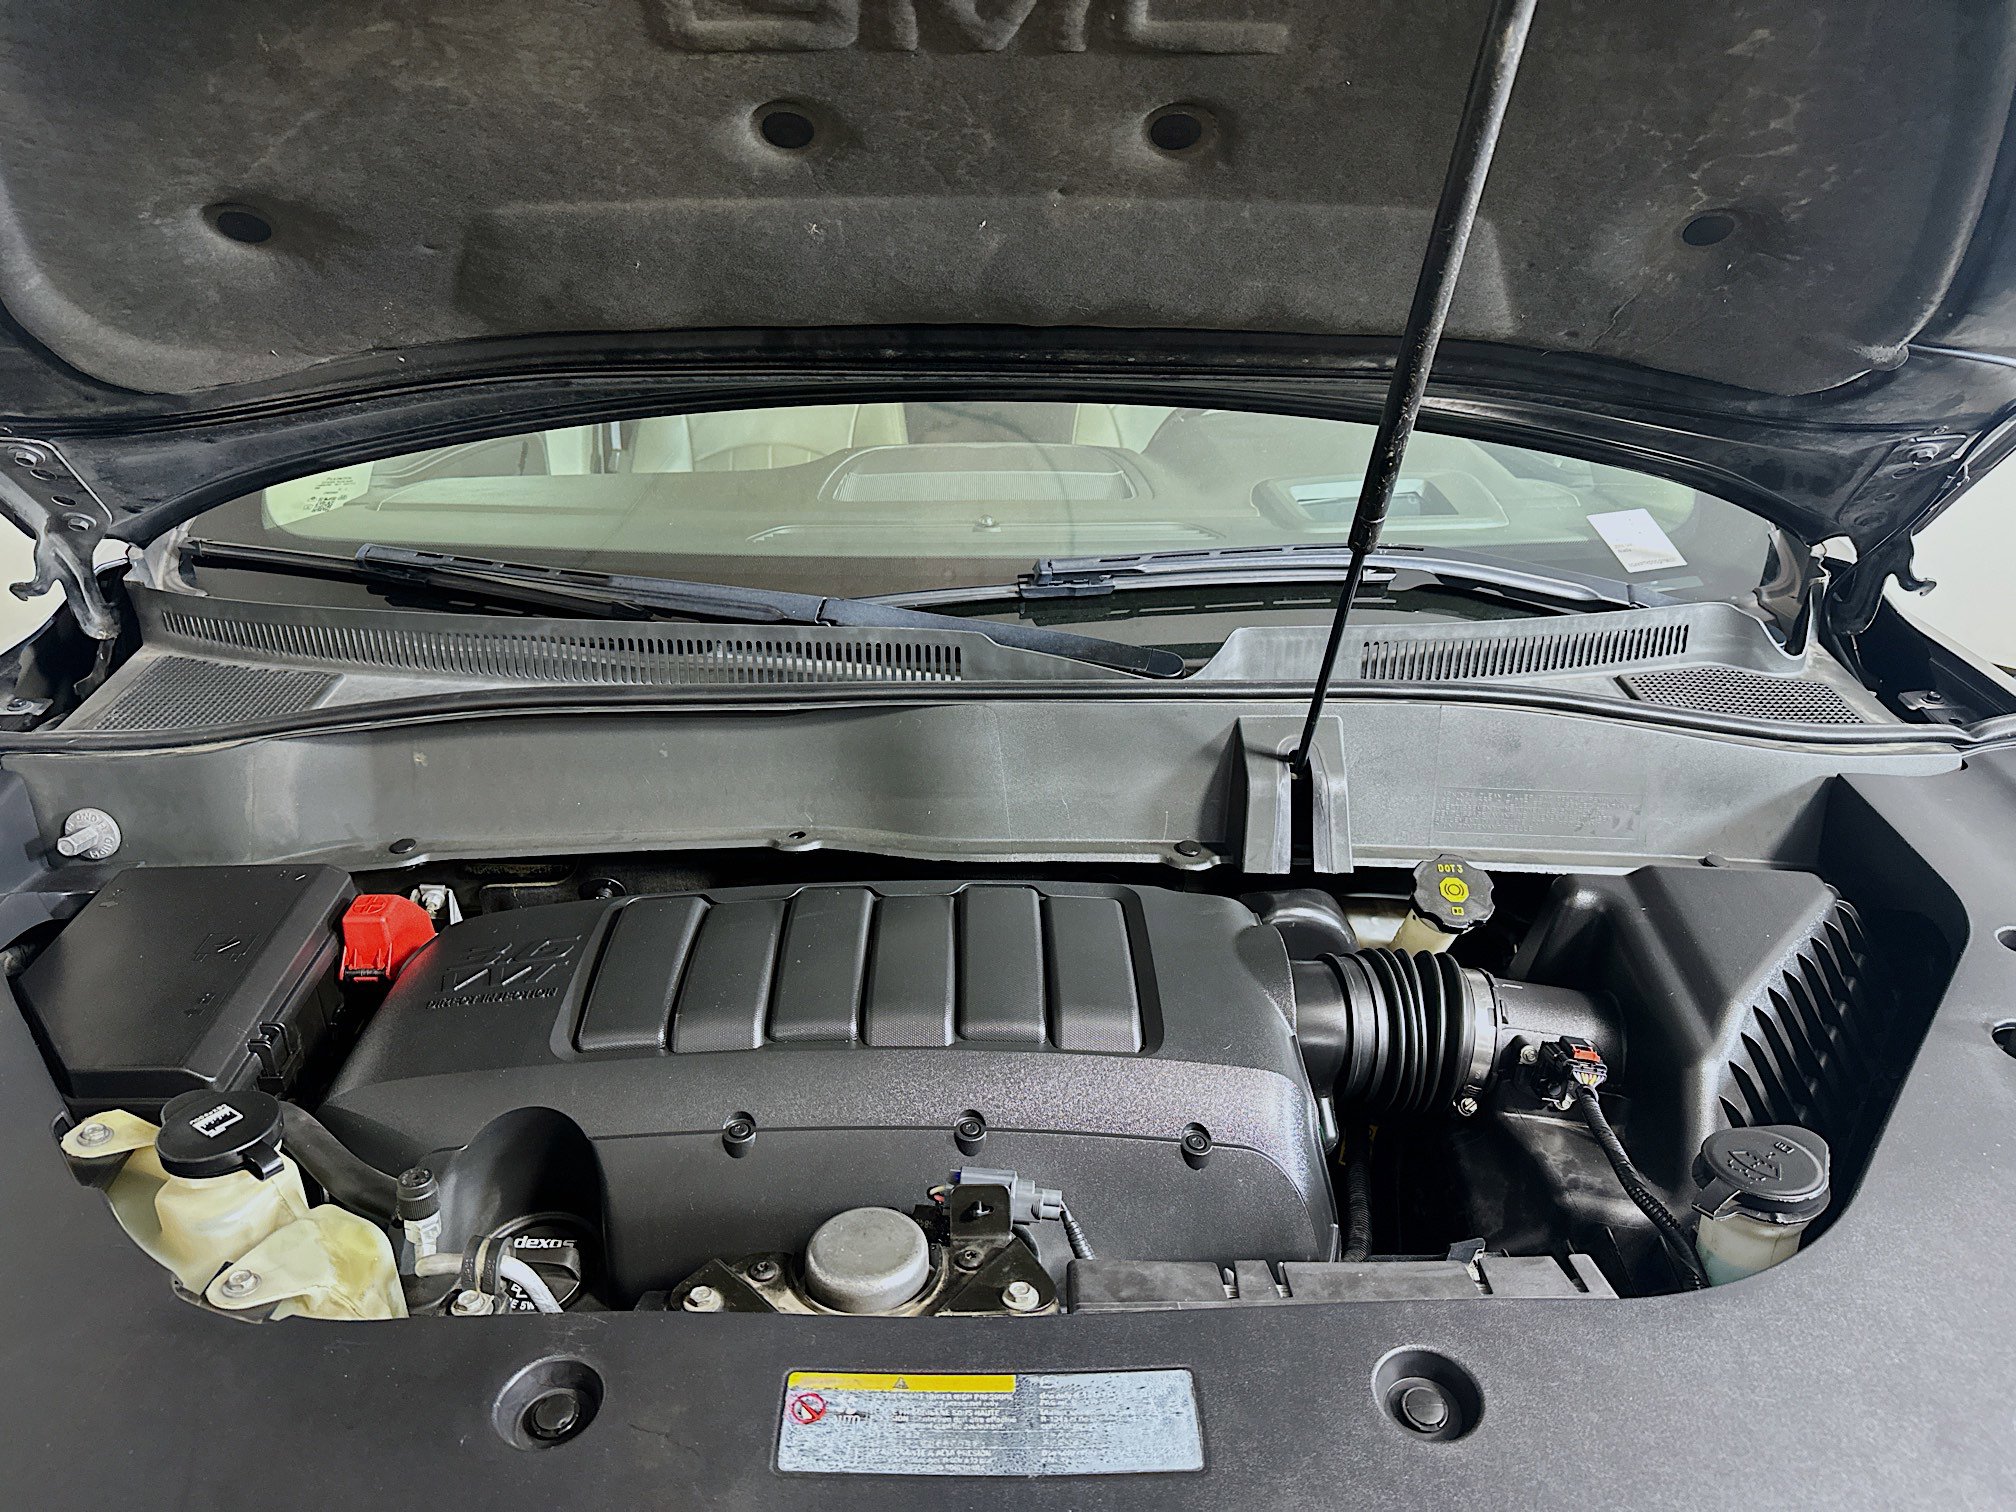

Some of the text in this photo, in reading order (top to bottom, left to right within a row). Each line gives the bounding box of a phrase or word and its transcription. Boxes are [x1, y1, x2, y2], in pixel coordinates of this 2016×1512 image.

[1437, 863, 1464, 873] DOT 3
[447, 934, 581, 971] 3.6
[426, 987, 560, 1010] DIRECT INJECTION
[513, 1236, 578, 1249] dexos
